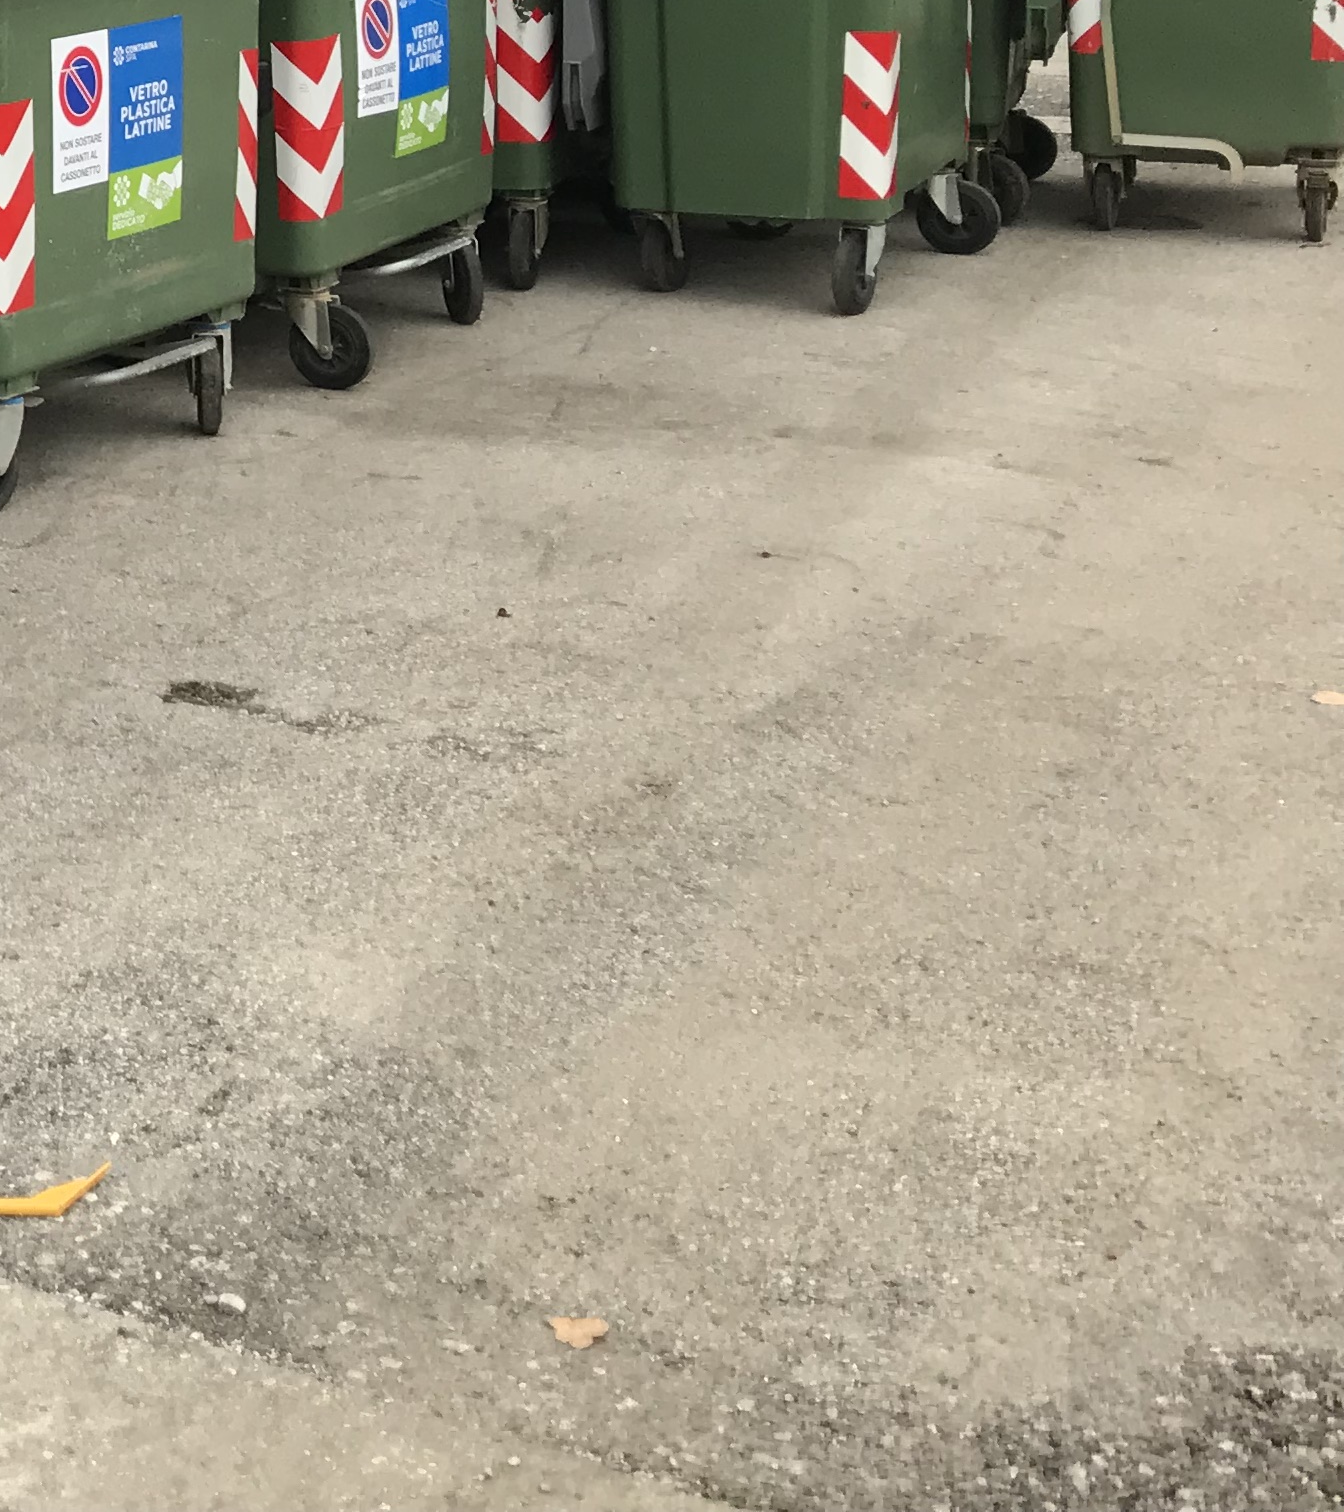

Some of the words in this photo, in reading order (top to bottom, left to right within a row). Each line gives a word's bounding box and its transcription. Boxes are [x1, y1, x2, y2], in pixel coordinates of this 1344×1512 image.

[411, 19, 439, 40] VETRO
[406, 34, 444, 58] PLASTICA
[409, 50, 442, 72] LATTINE
[129, 79, 168, 102] VETRO
[120, 95, 176, 123] PLASTICA
[124, 114, 172, 140] LATTINE
[60, 139, 74, 152] NON
[63, 151, 90, 167] DAVANTI
[60, 164, 101, 183] CASSONETTO
